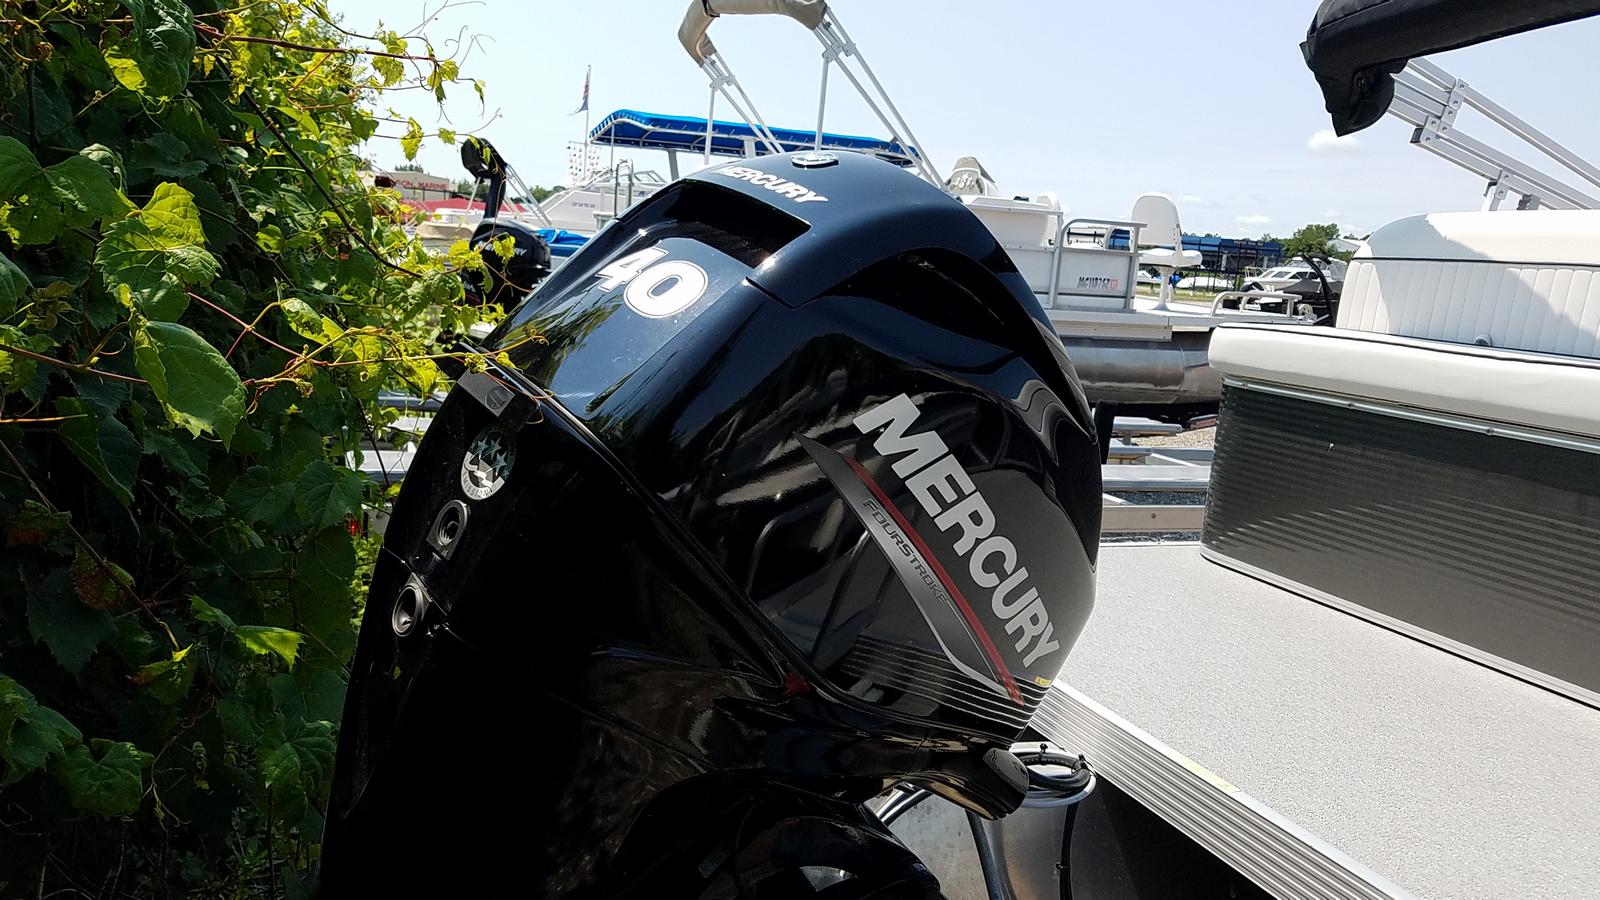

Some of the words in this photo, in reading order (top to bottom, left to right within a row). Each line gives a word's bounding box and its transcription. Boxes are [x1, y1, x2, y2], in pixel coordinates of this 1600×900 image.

[711, 165, 829, 203] MERCURY
[595, 245, 709, 318] 40
[852, 392, 1060, 668] MERCURY
[862, 497, 948, 605] FOURSTROKE
